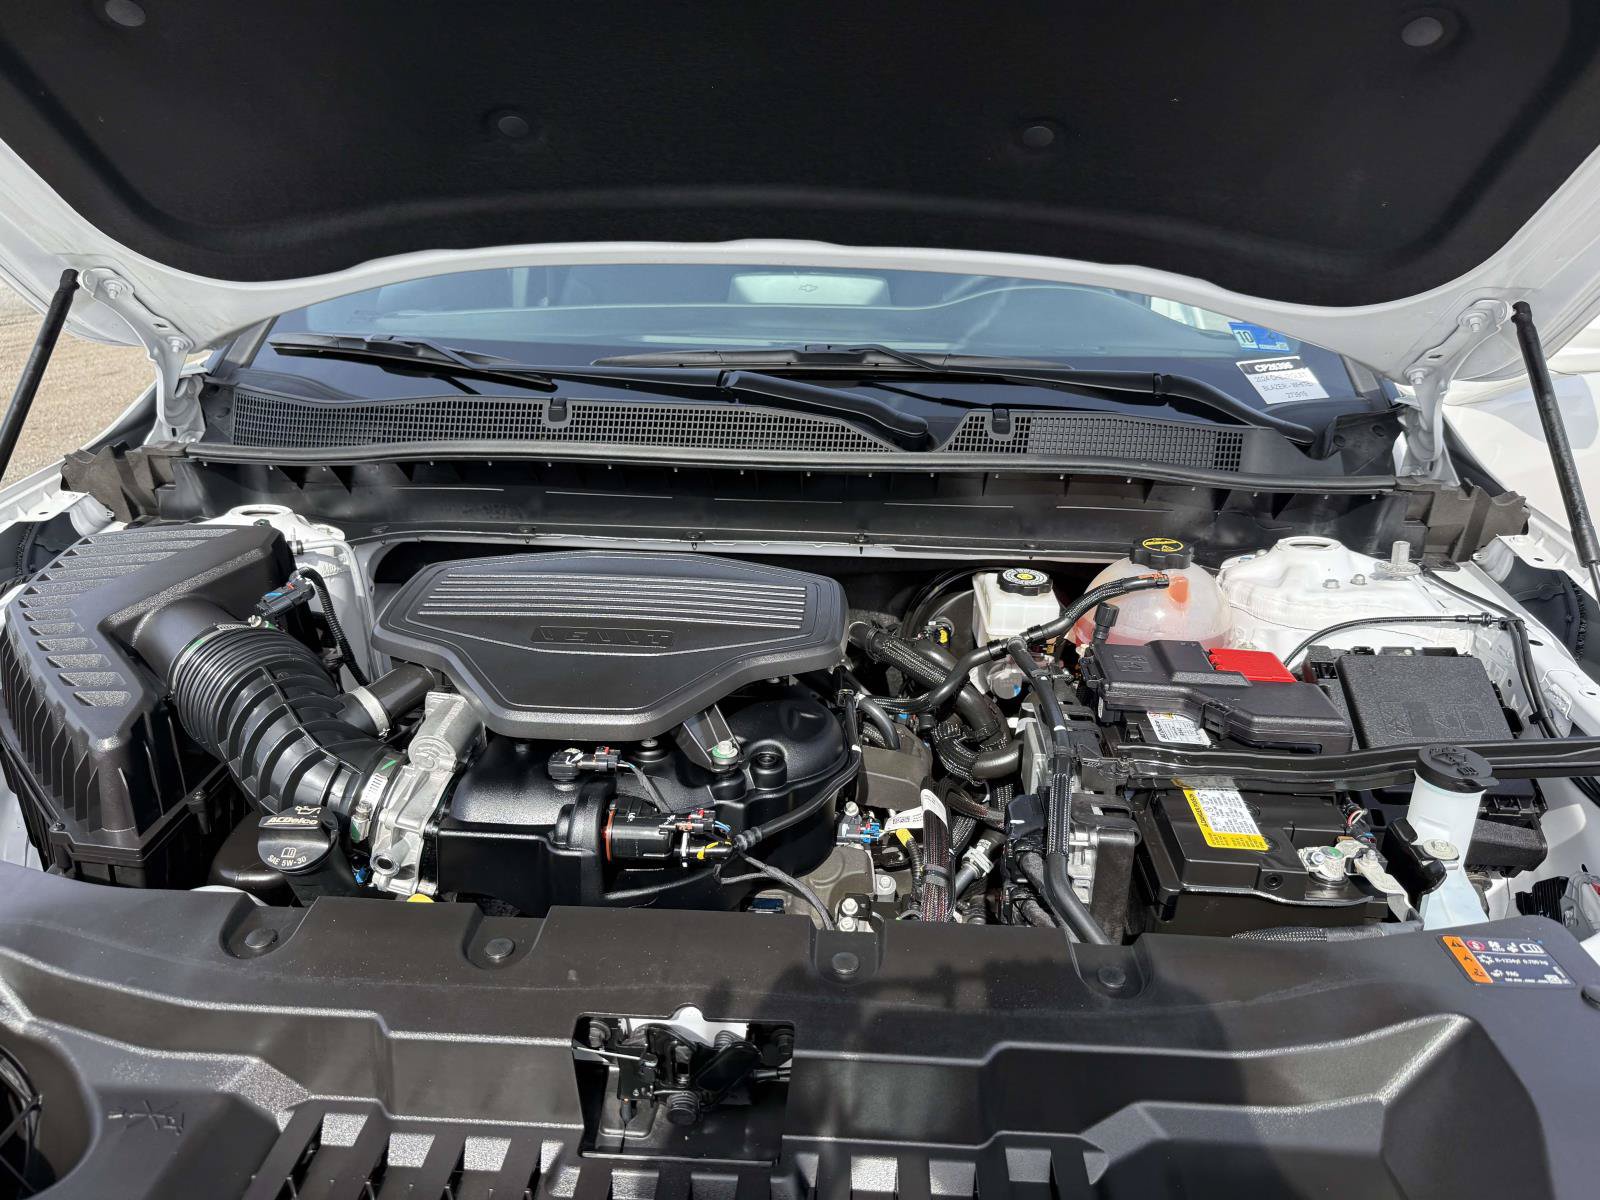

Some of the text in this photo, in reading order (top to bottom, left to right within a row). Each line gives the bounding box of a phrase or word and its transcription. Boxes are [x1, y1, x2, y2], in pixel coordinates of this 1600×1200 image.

[264, 816, 319, 826] ACDelco
[267, 854, 307, 867] SAE 5W-30
